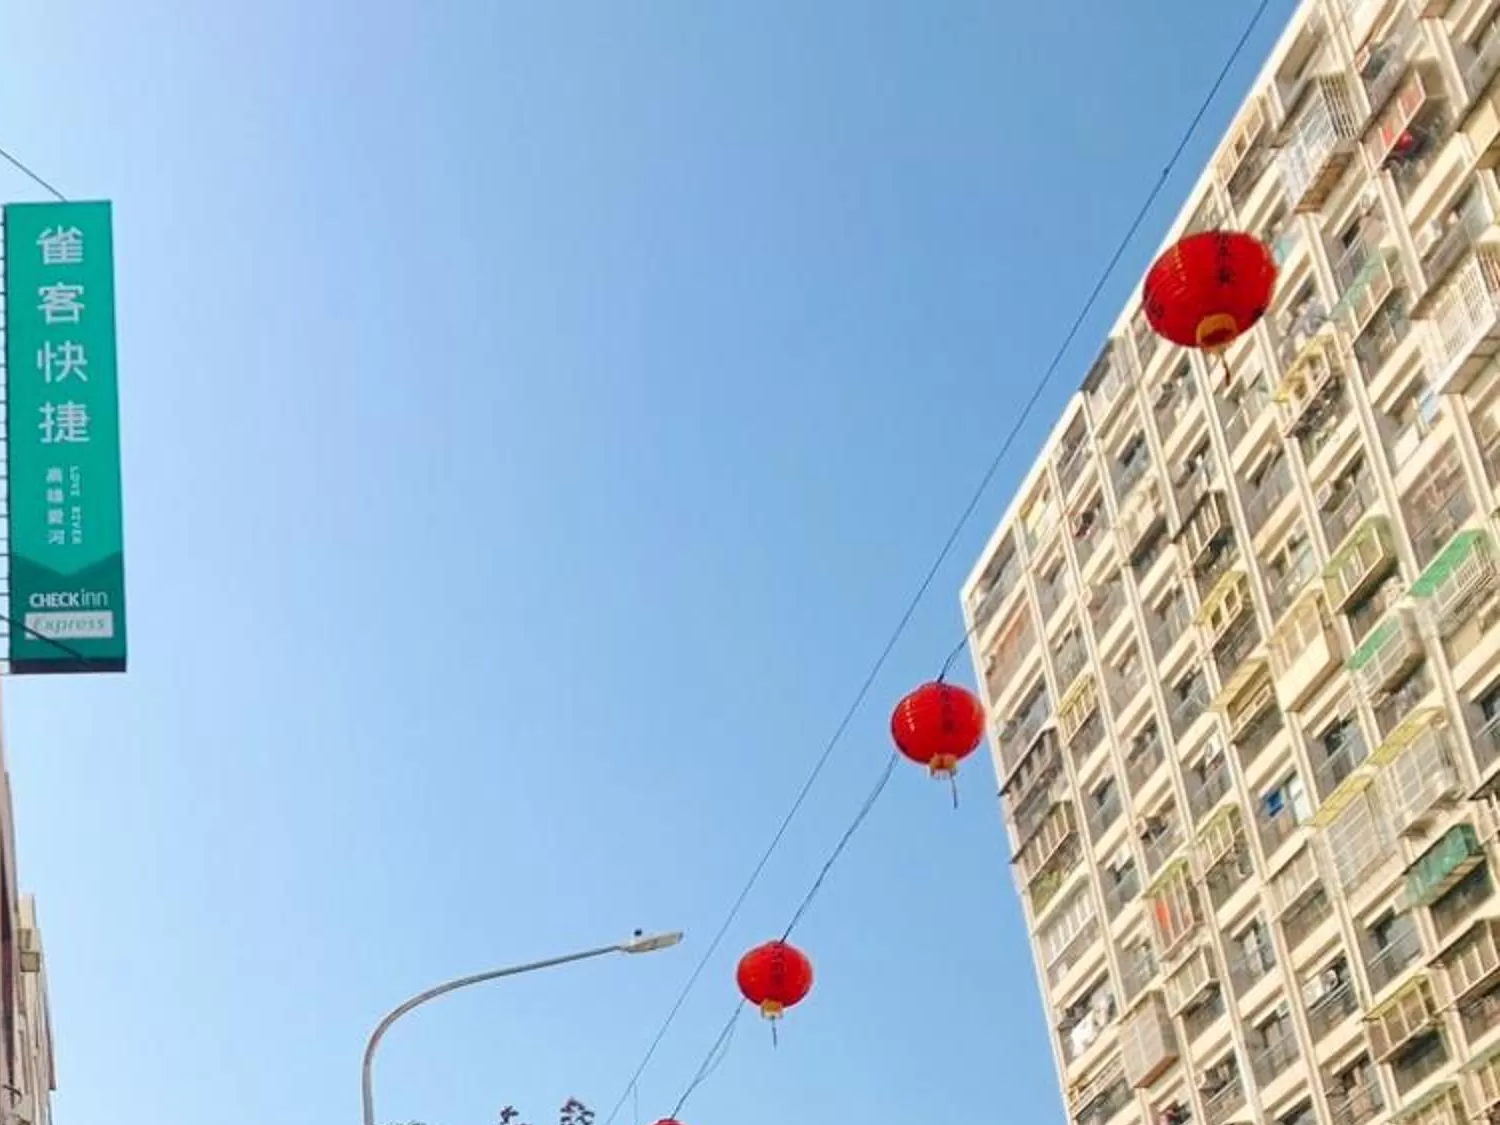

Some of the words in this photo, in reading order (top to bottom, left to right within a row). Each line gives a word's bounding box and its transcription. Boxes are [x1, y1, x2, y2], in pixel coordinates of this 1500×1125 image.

[37, 226, 90, 443] 雀客快捷
[33, 617, 106, 637] Express
